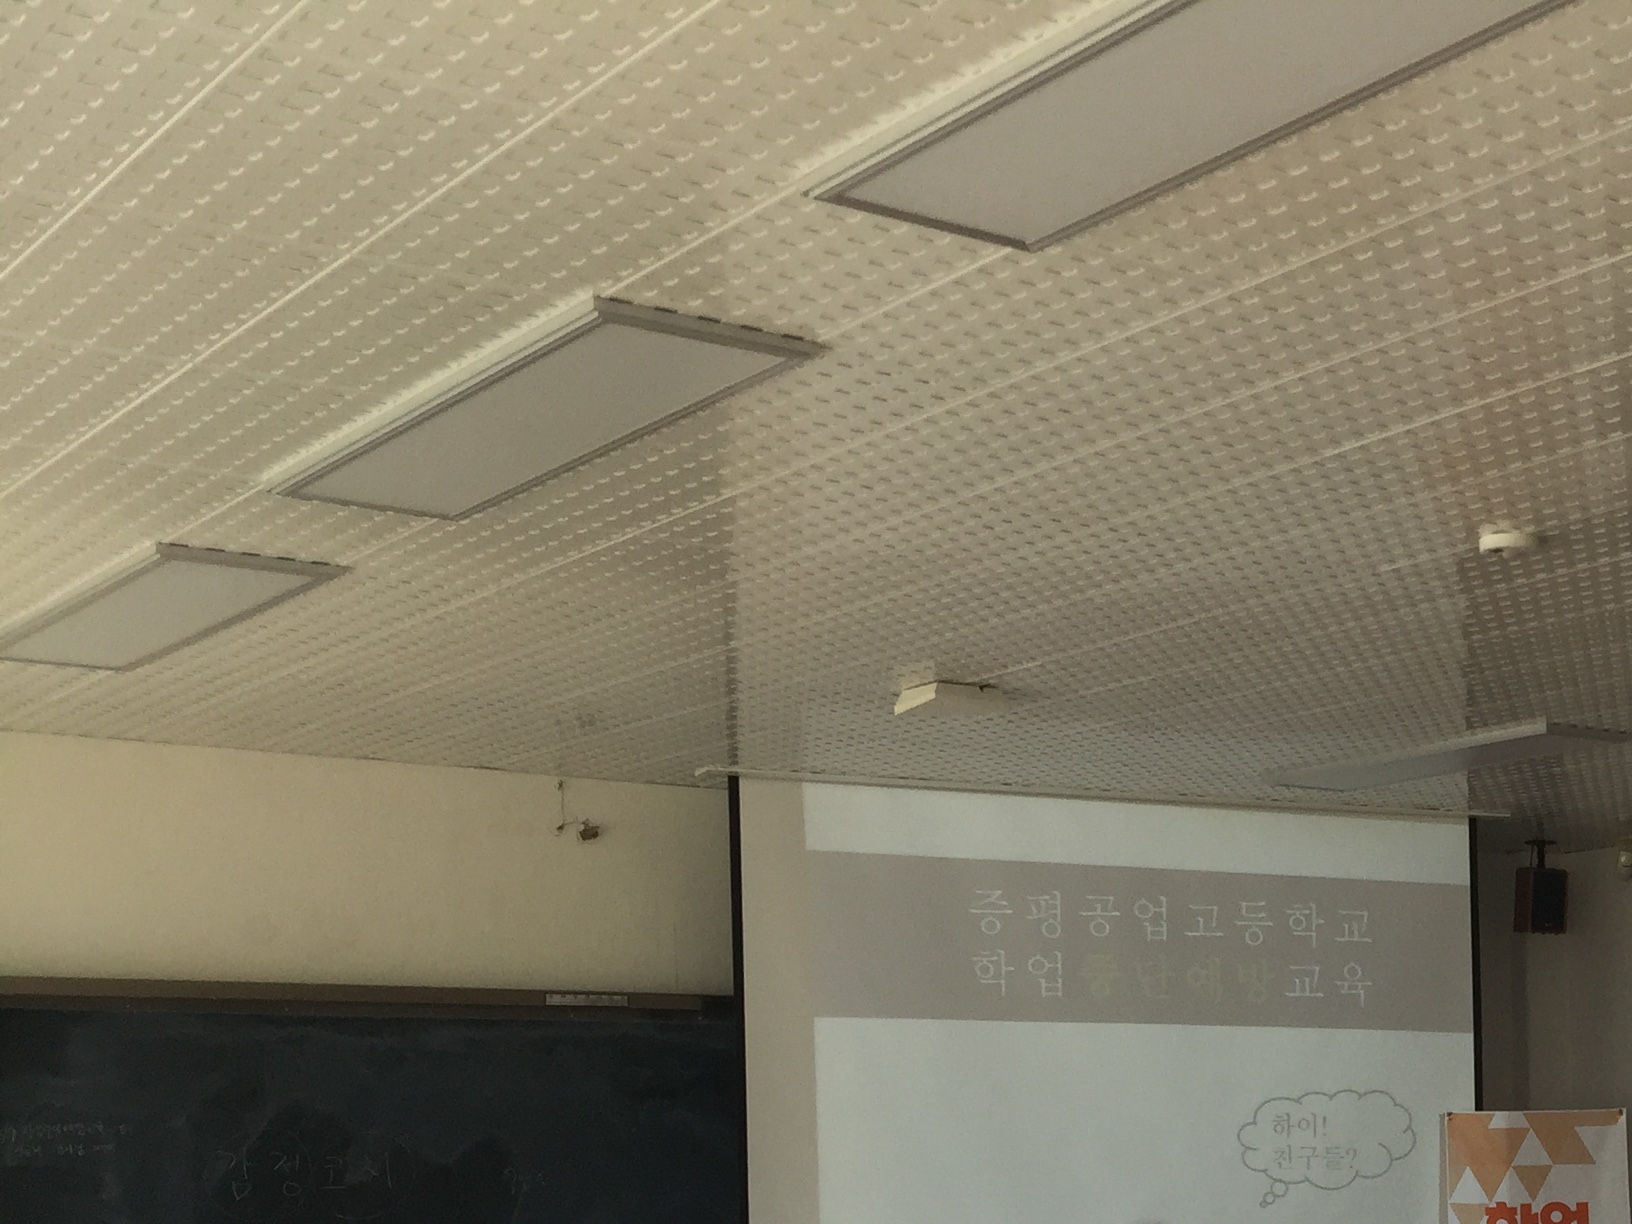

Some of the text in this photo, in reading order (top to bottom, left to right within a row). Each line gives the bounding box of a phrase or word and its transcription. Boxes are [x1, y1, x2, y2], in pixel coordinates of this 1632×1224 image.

[970, 888, 1373, 947] 증평공업고등학교
[1272, 1112, 1328, 1138] 하이!
[1272, 1144, 1358, 1171] 친구들?
